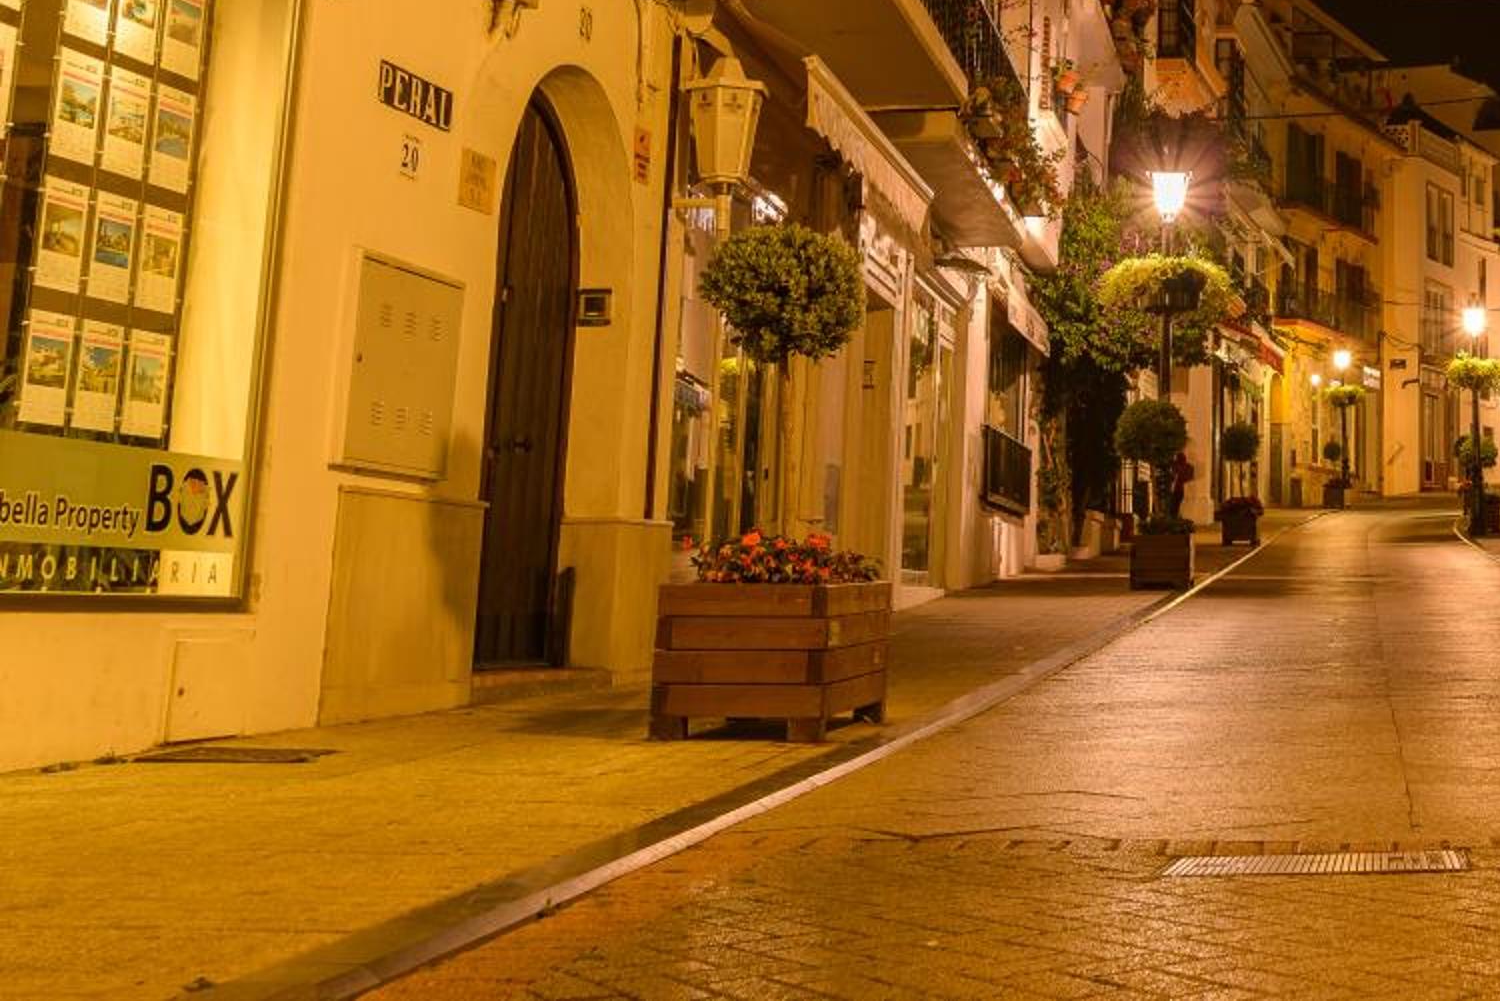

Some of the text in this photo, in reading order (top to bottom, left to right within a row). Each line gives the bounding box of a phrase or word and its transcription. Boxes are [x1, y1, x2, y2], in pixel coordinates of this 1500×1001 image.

[378, 62, 450, 130] PERAL
[402, 143, 419, 172] 20
[55, 497, 140, 539] Property
[146, 464, 238, 537] BOX
